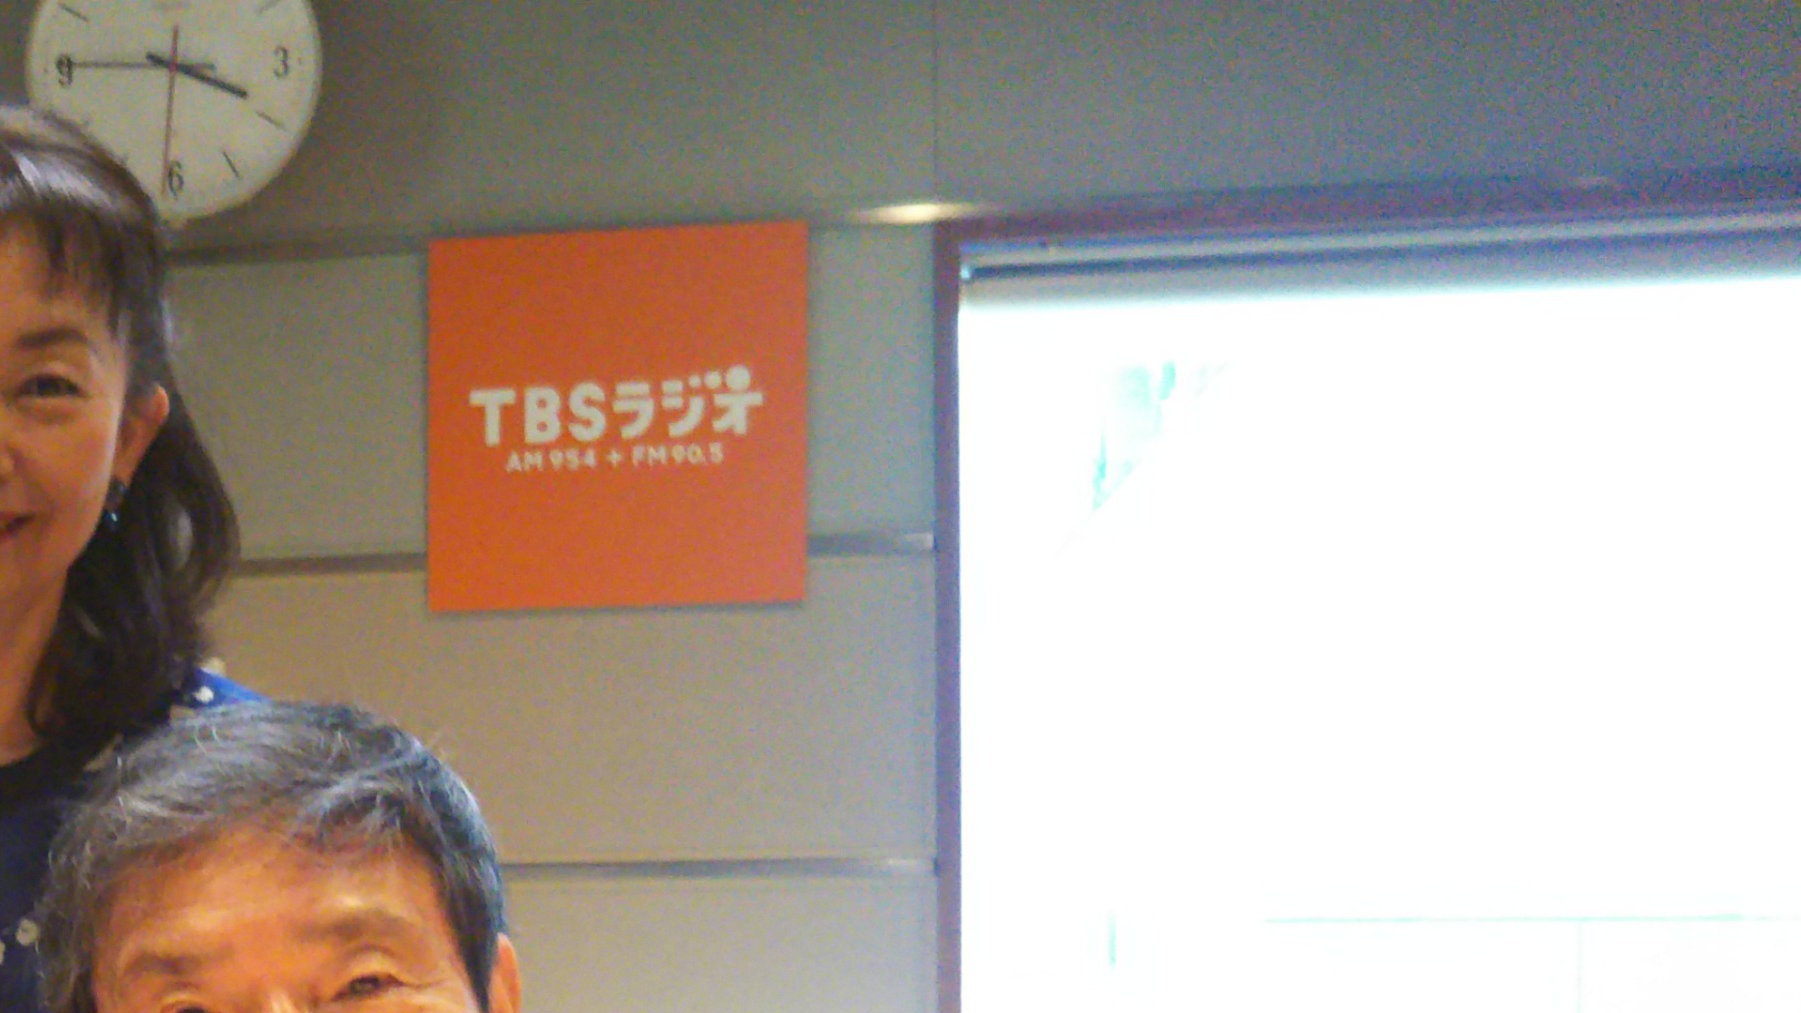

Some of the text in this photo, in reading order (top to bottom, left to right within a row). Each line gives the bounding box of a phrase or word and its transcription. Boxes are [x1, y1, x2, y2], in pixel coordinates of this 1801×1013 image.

[56, 54, 74, 86] 9
[274, 46, 289, 78] 3
[166, 161, 184, 197] 6
[469, 364, 764, 447] TBSラジオ
